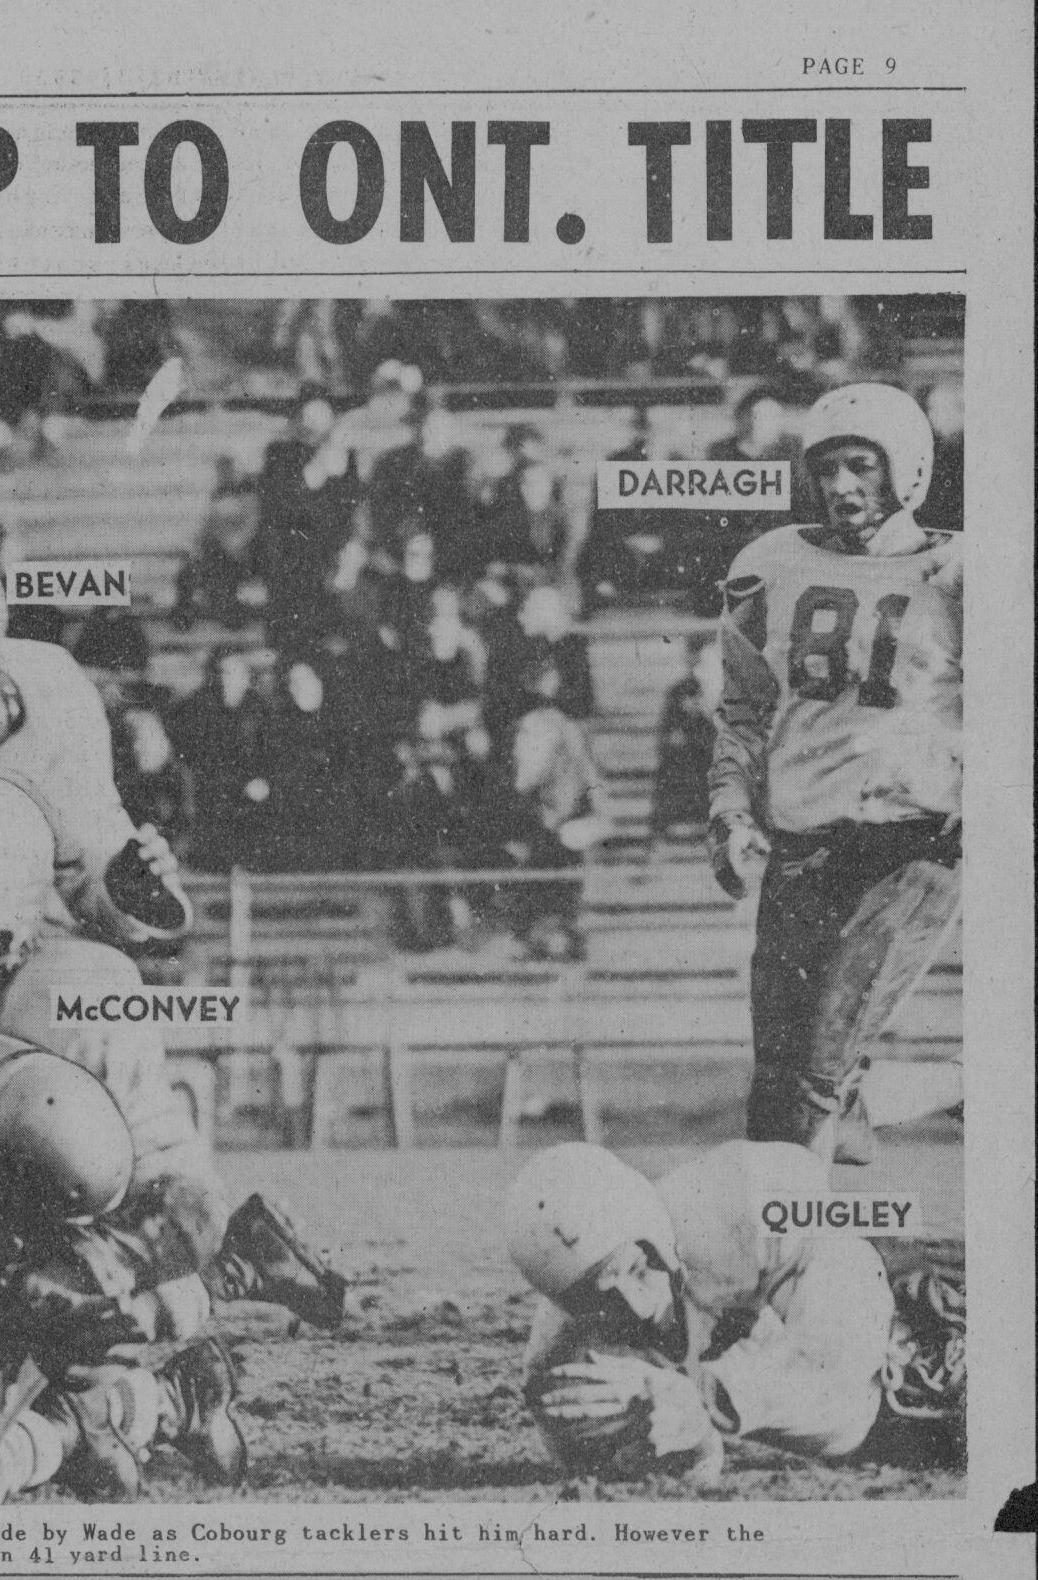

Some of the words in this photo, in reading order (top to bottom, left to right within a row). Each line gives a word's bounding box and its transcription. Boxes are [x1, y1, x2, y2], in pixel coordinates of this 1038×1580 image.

[803, 57, 863, 75] PAGE
[886, 58, 896, 73] 9
[76, 120, 229, 245] TO
[299, 120, 585, 245] ONT.
[628, 118, 933, 243] TITLE
[618, 469, 782, 497] DARRAGH
[15, 571, 125, 598] BEVAN
[788, 586, 910, 709] 81
[56, 995, 240, 1022] McCONVEY
[762, 1201, 912, 1233] QUIGLEY
[43, 1522, 67, 1545] by
[83, 1523, 135, 1541] Wade
[152, 1529, 177, 1542] as
[191, 1522, 286, 1545] Cobourg
[303, 1523, 409, 1541] tacklers
[424, 1523, 462, 1541] hit
[478, 1524, 522, 1542] him
[534, 1523, 595, 1541] hard.
[615, 1523, 709, 1542] However
[727, 1524, 764, 1541] the
[30, 1547, 53, 1564] 41
[70, 1545, 122, 1564] yard
[140, 1545, 199, 1562] line.
